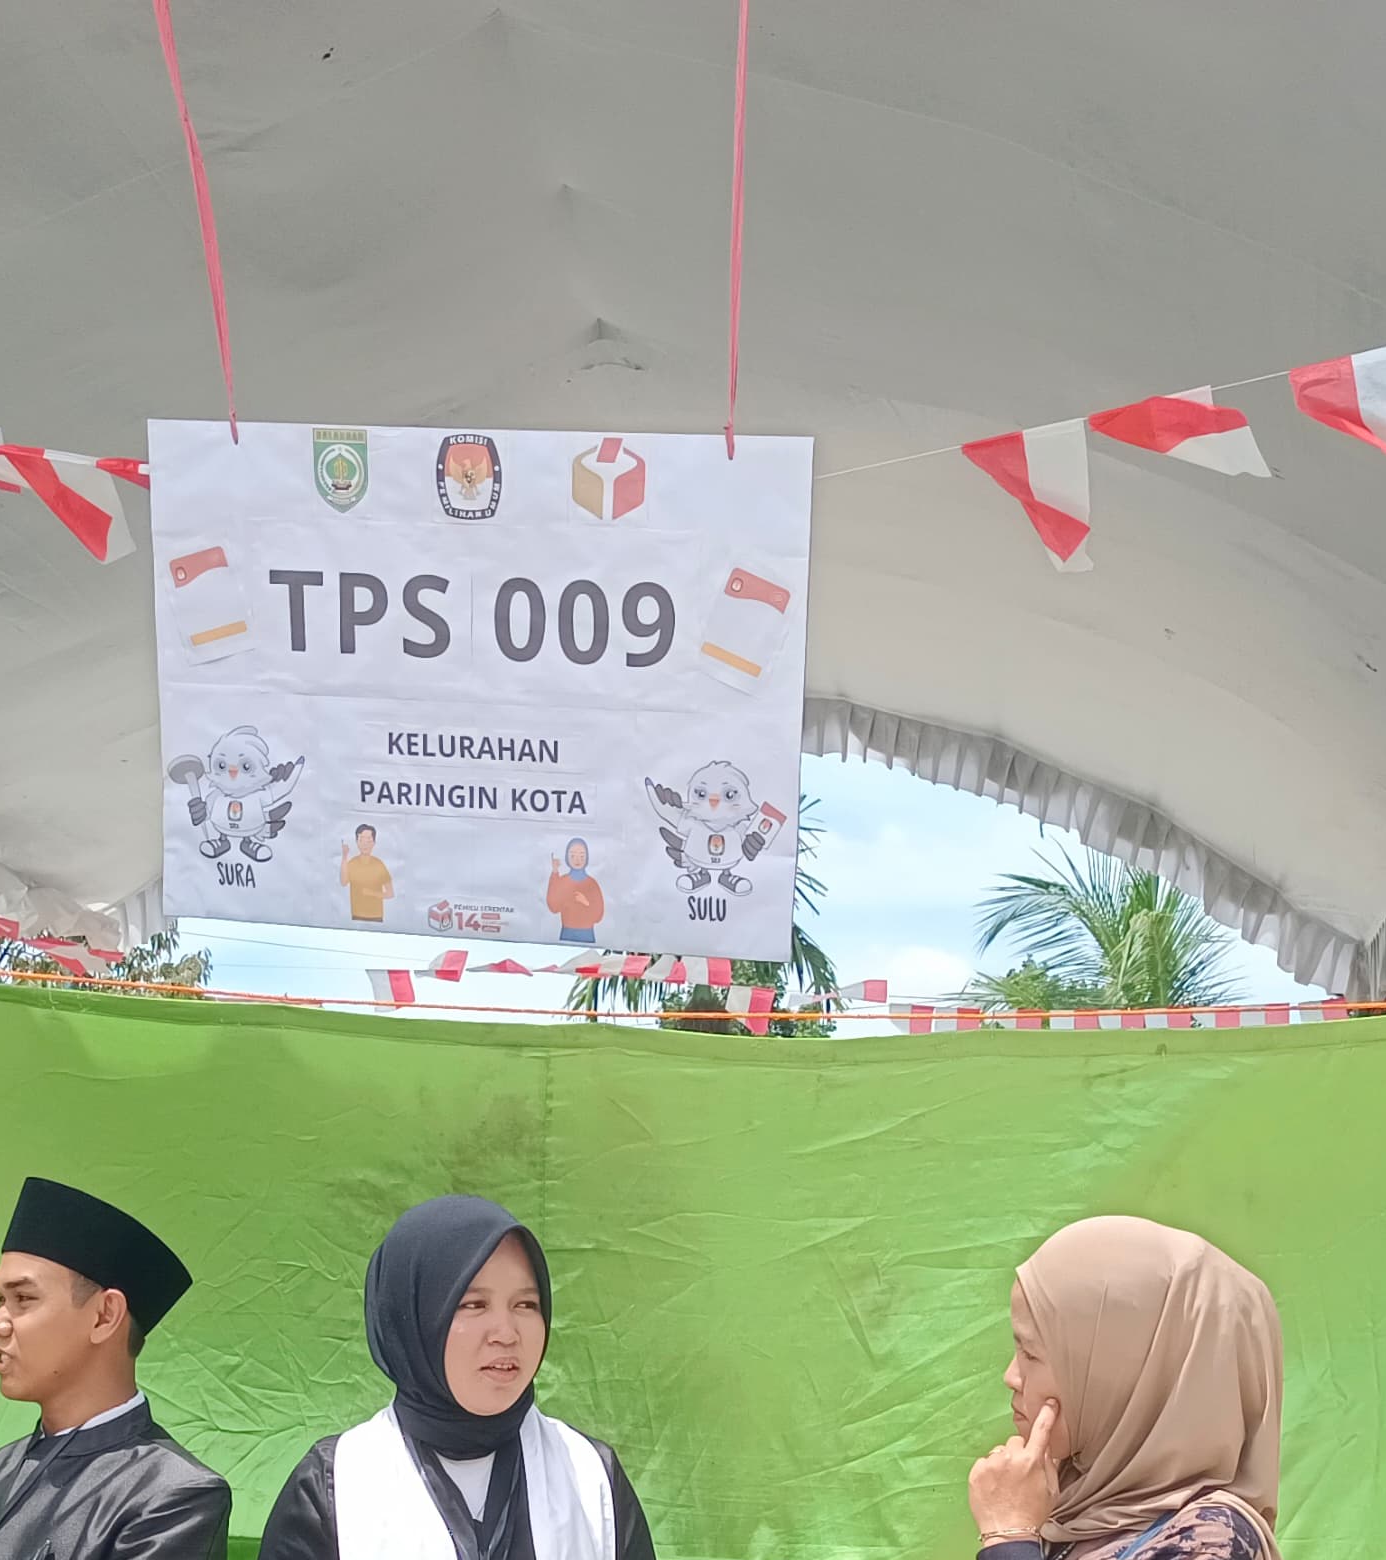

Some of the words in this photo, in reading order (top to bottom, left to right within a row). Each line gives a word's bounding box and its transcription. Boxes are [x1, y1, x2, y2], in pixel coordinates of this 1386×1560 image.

[449, 433, 488, 446] KOMISI
[268, 568, 452, 659] TPS
[493, 576, 676, 668] 009
[386, 731, 560, 764] KELURAHAN
[359, 779, 499, 812] PARINGIN
[510, 787, 588, 816] KOTA
[216, 861, 256, 888] SURA
[454, 912, 481, 931] 14
[687, 895, 727, 922] SULU
